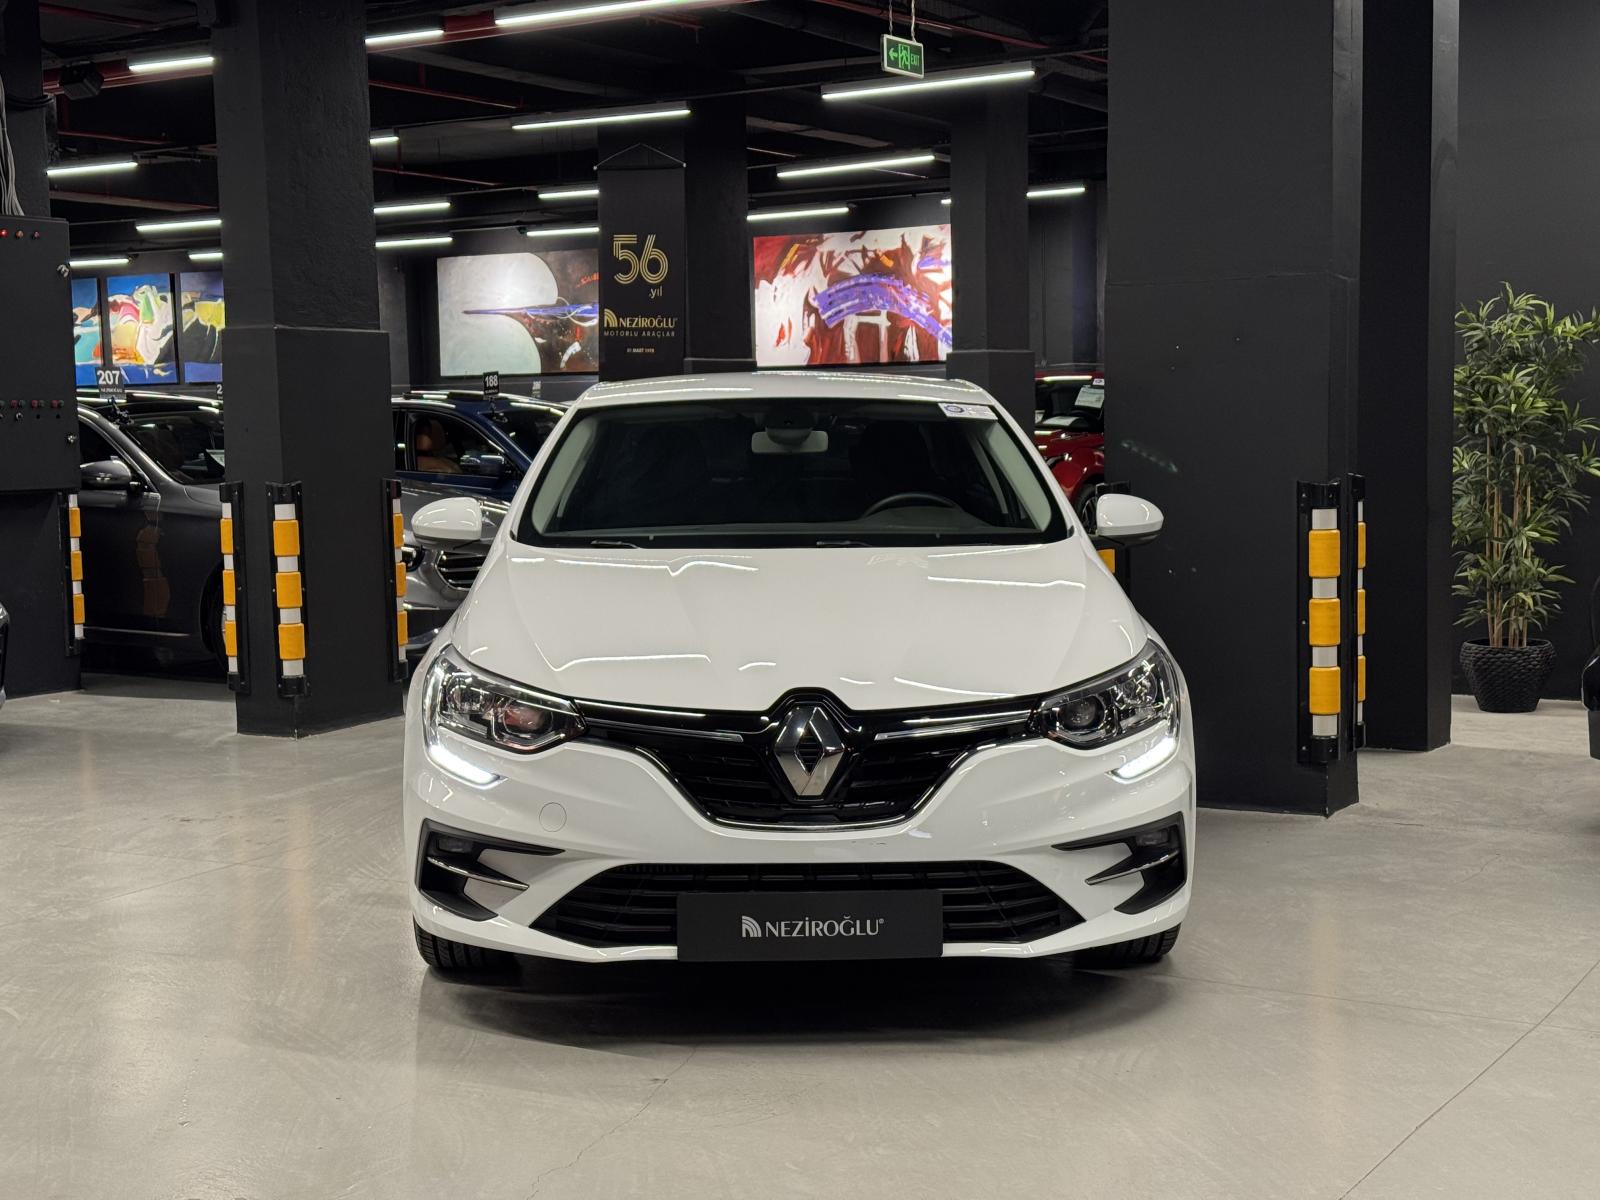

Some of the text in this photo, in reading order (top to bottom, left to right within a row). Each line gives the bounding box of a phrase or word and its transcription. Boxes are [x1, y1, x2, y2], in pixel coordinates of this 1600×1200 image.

[911, 54, 920, 66] EXIT
[613, 234, 669, 284] 56
[641, 330, 675, 338] ARAÇLAR
[96, 370, 120, 385] 207
[765, 915, 880, 938] NEZİROĞLU
